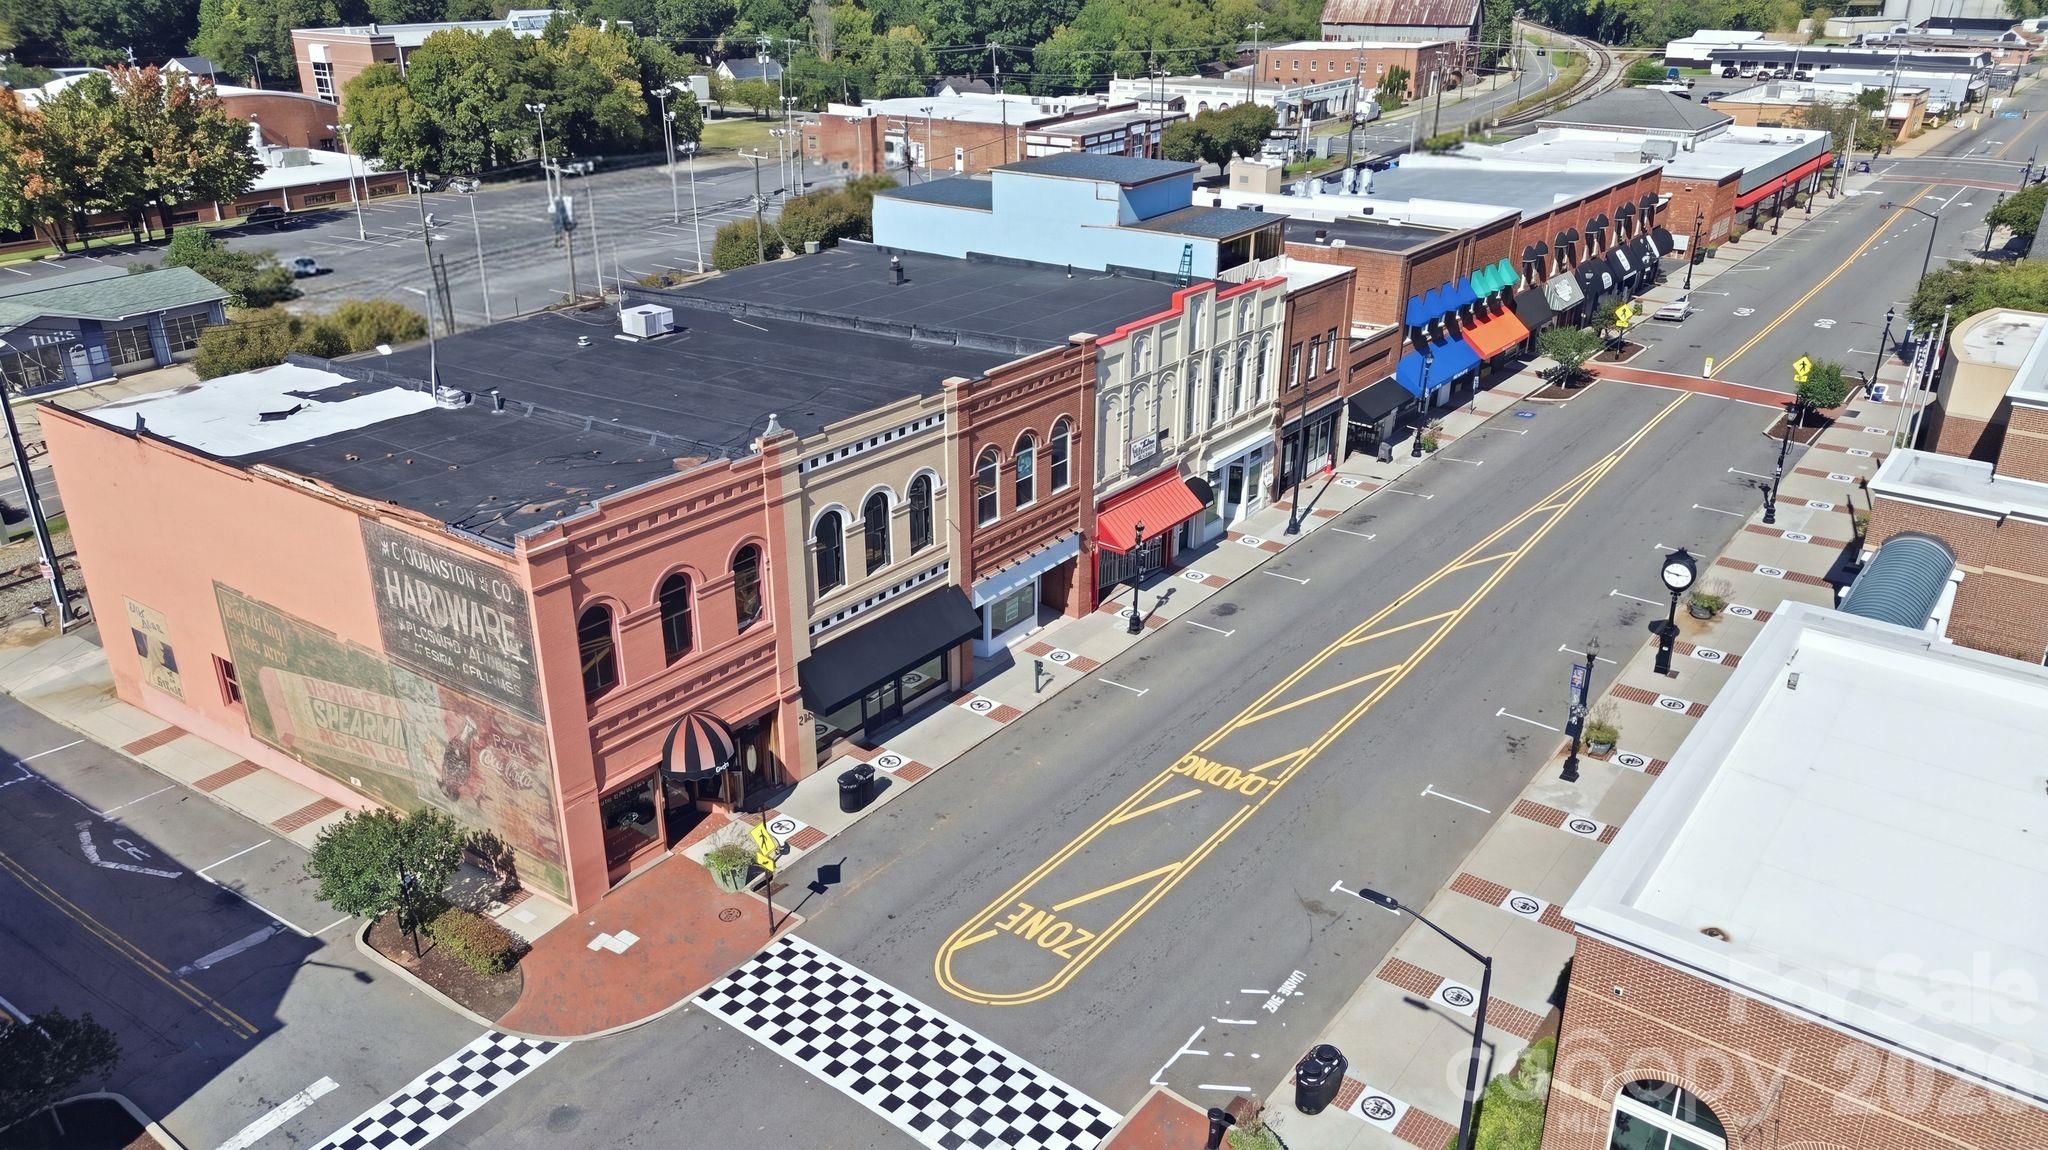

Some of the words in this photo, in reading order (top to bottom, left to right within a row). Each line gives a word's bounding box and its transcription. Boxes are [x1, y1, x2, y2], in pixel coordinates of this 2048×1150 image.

[383, 566, 521, 655] HARDWARE
[492, 579, 515, 605] CO.
[994, 902, 1096, 960] ZONE
